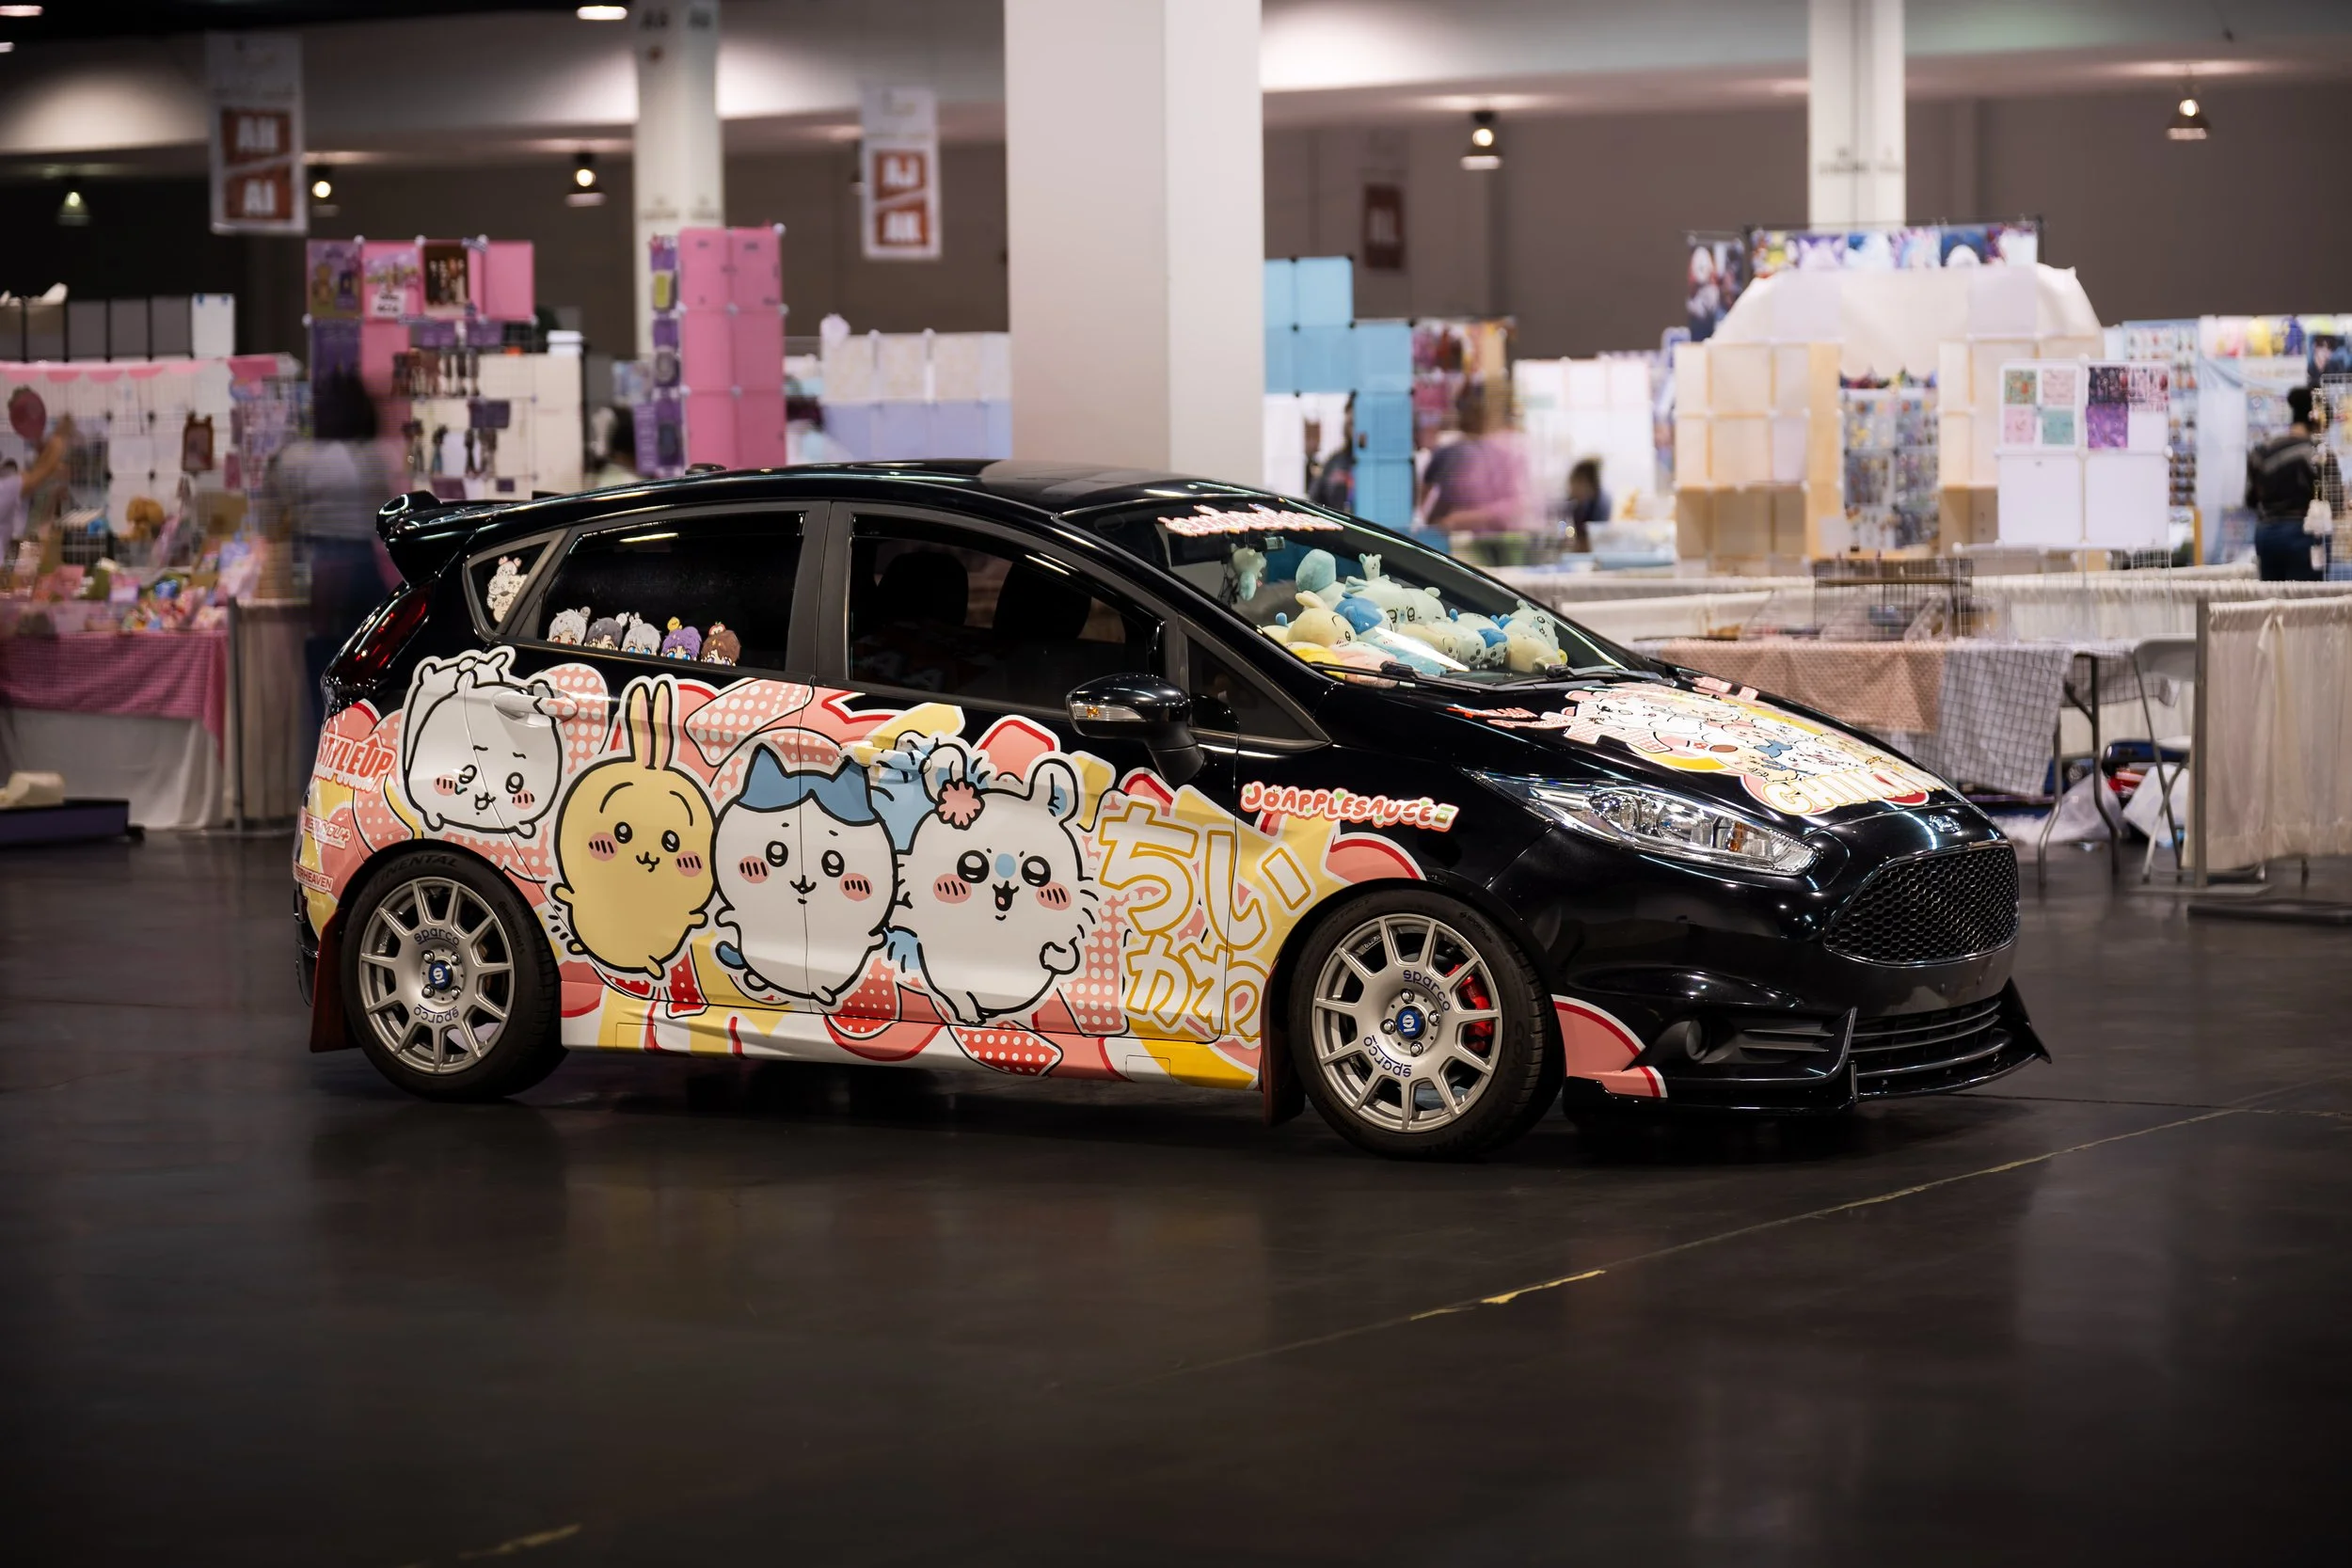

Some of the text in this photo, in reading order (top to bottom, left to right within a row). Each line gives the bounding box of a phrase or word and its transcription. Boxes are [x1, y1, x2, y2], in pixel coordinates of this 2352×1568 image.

[1245, 784, 1434, 822] JOAPPLESAUCE
[414, 926, 460, 946] sparco
[1403, 969, 1451, 1012] sparco
[1363, 1035, 1412, 1078] sparco
